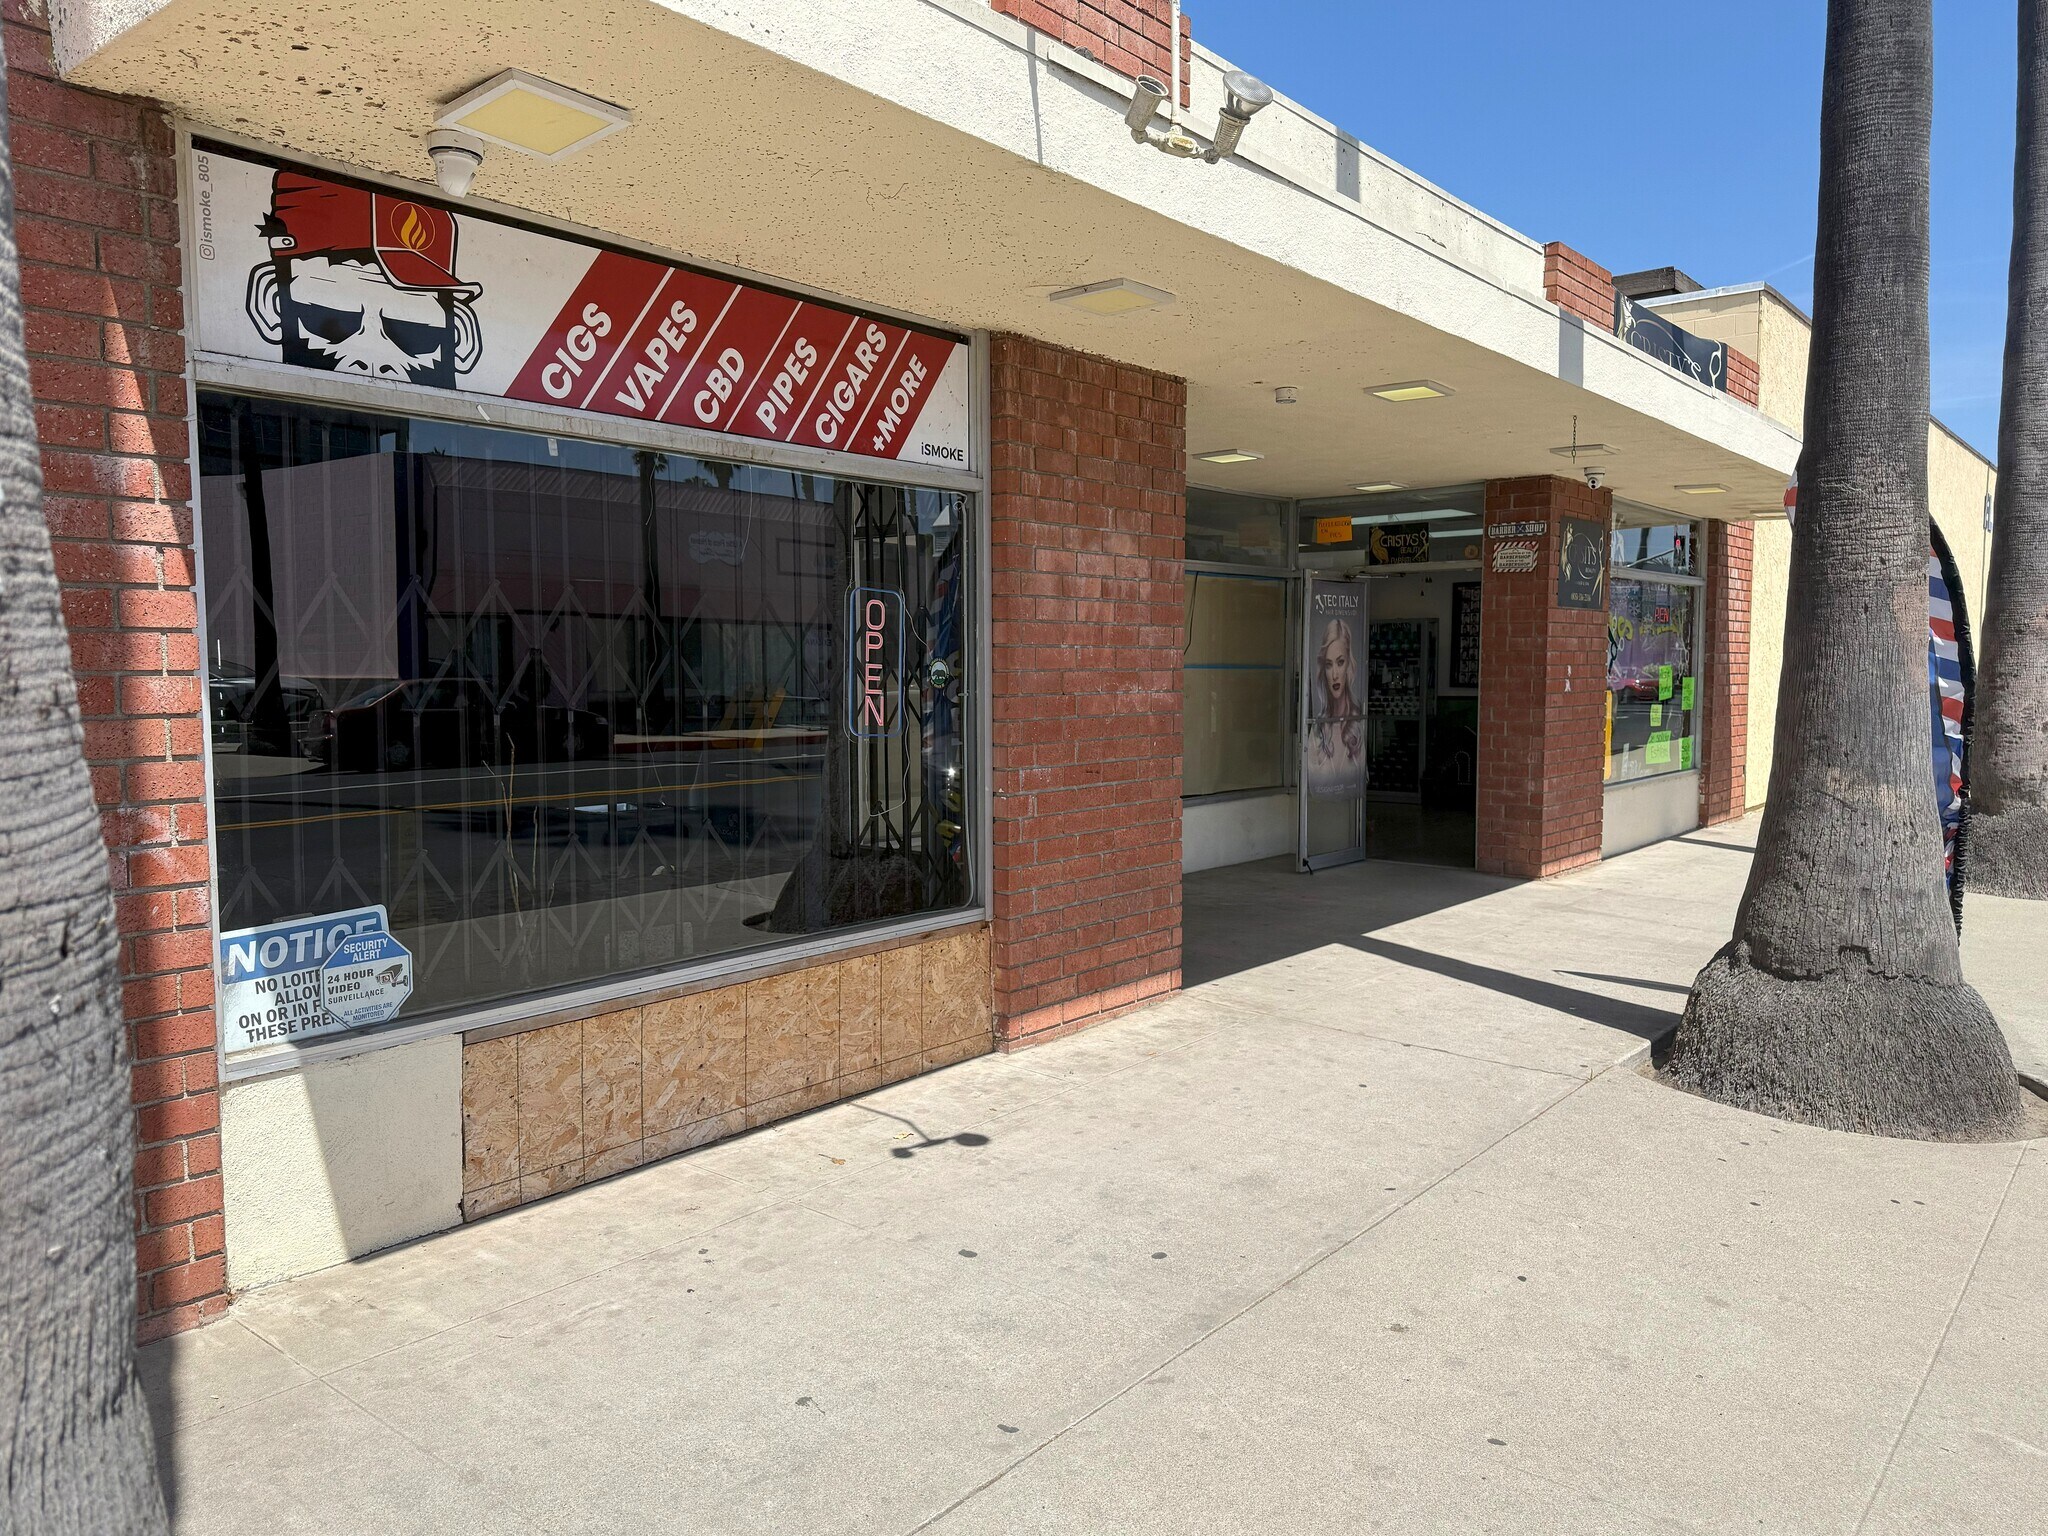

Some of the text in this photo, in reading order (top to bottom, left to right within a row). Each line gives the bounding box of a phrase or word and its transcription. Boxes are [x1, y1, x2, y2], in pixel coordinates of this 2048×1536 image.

[197, 155, 214, 243] ismoke_805
[541, 302, 612, 400] CIGS
[614, 299, 698, 412] VAPES
[693, 347, 745, 424] CBD
[755, 336, 819, 434] PIPES
[814, 322, 887, 444] CIGARS
[872, 353, 929, 452] +MORE
[920, 441, 964, 462] iSMOKE
[1491, 524, 1544, 535] BARBER SHOP
[1323, 595, 1359, 608] TEC ITALY
[864, 599, 886, 726] OPEN
[343, 938, 388, 954] SECURITY
[352, 949, 381, 962] ALERT
[255, 978, 278, 994] NO
[327, 969, 374, 984] 24 HOUR
[328, 982, 361, 995] VIDEO
[328, 988, 385, 1005] SURVEILLANCE
[239, 1012, 261, 1029] ON
[266, 1007, 289, 1023] OR
[293, 1002, 308, 1018] IN
[352, 1010, 384, 1021] MONITORED
[354, 1004, 382, 1015] ACTIVITIES
[246, 1020, 297, 1043] THESE
